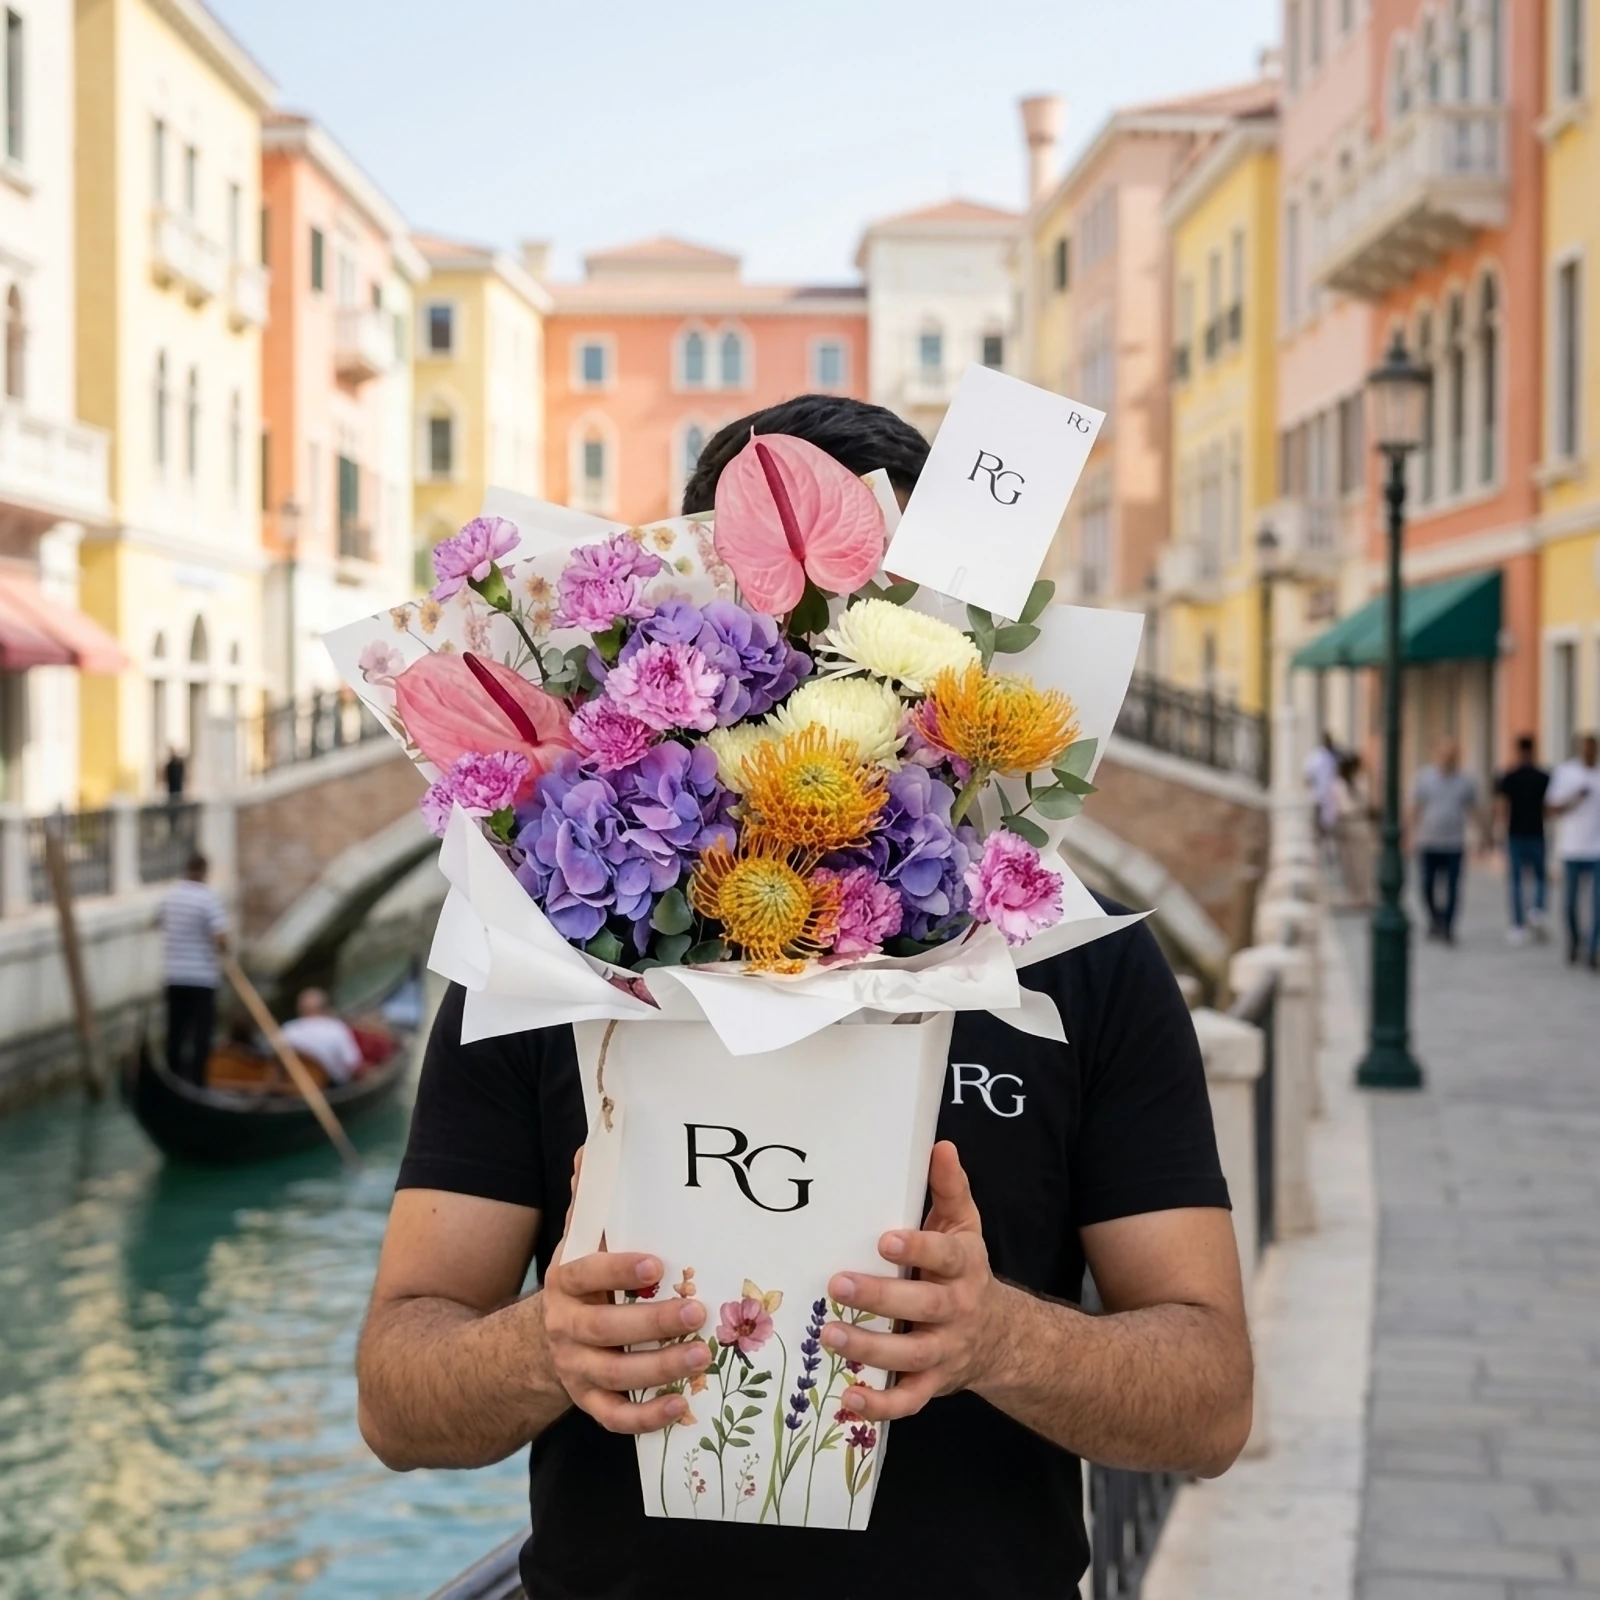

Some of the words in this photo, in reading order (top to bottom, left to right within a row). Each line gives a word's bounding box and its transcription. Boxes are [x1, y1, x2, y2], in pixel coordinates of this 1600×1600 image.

[1067, 411, 1092, 434] RG
[967, 449, 1026, 505] RG
[950, 1063, 1027, 1118] RG
[683, 1122, 814, 1213] RG
